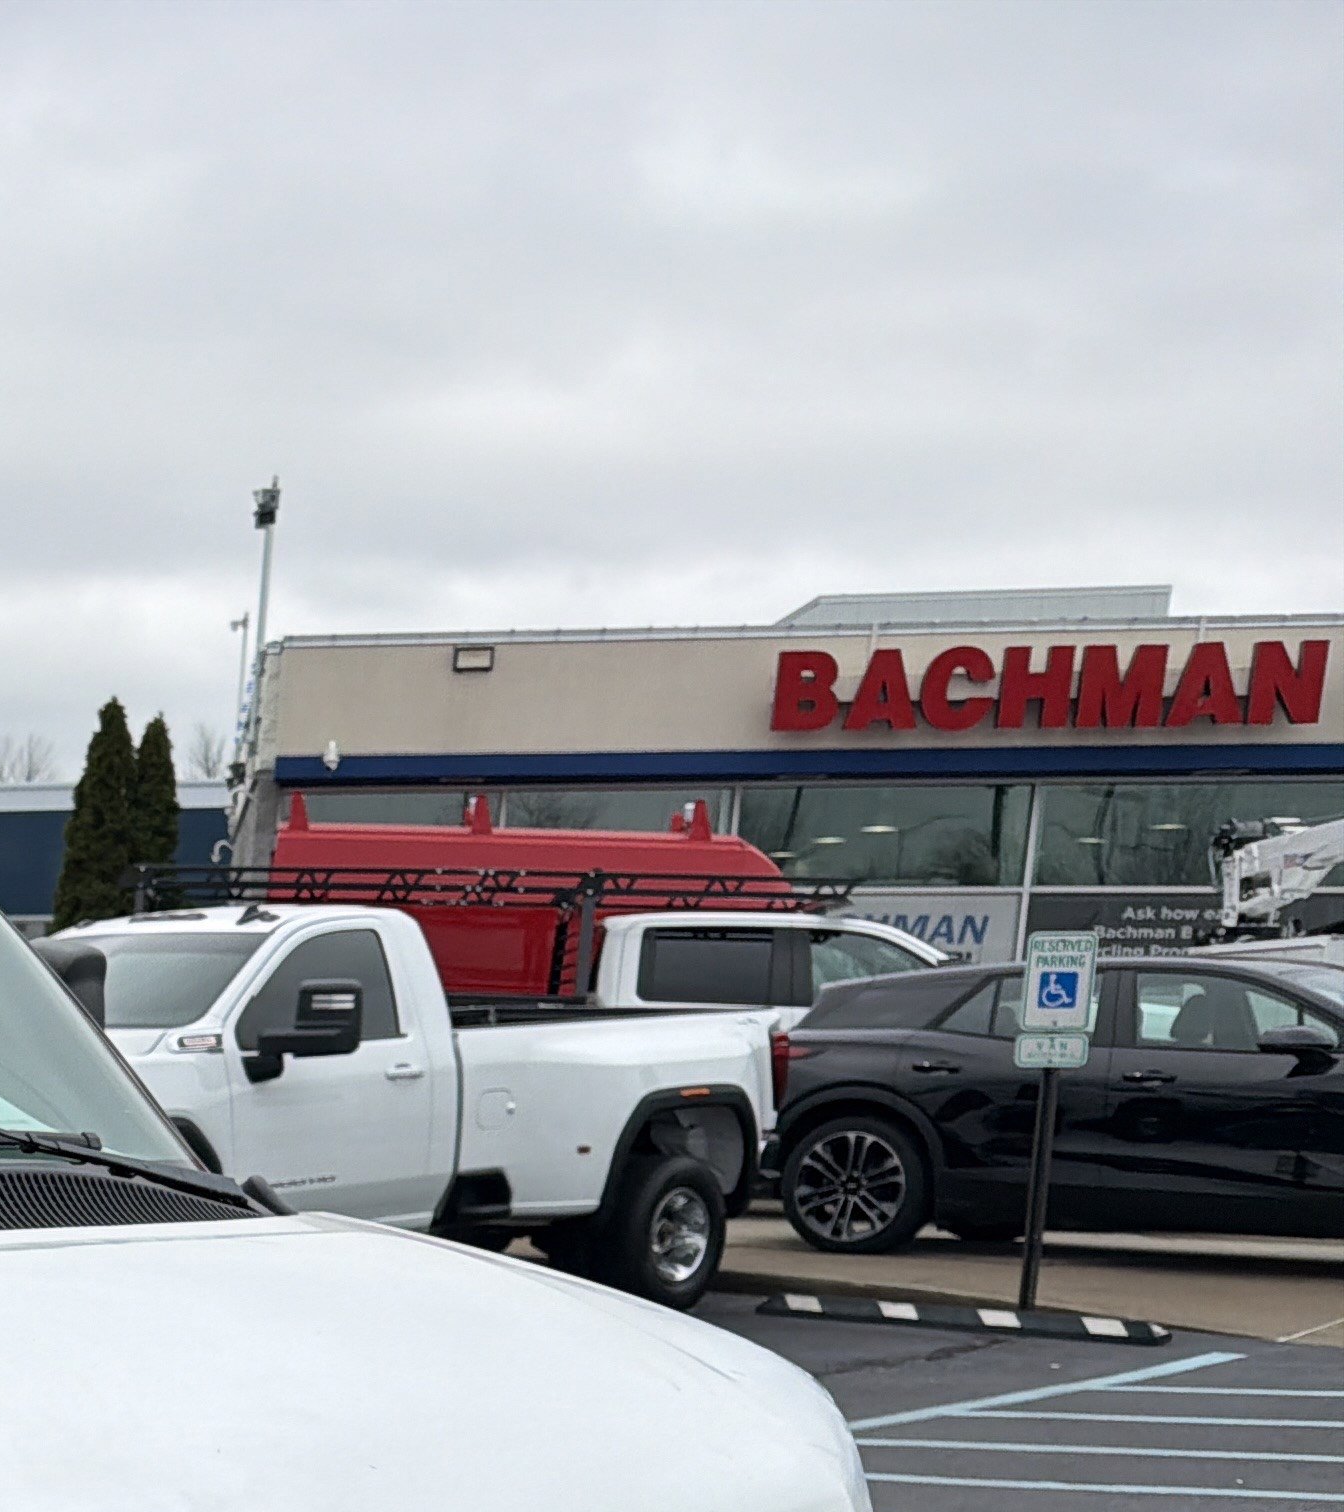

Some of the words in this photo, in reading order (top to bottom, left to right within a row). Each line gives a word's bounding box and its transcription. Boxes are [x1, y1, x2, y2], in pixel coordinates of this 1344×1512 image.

[771, 640, 1330, 732] BACHMAN
[1121, 906, 1155, 921] Ask
[1161, 906, 1199, 921] how
[1094, 925, 1176, 940] Bachman
[1033, 939, 1092, 952] RESERVED
[1037, 954, 1086, 967] PARKING
